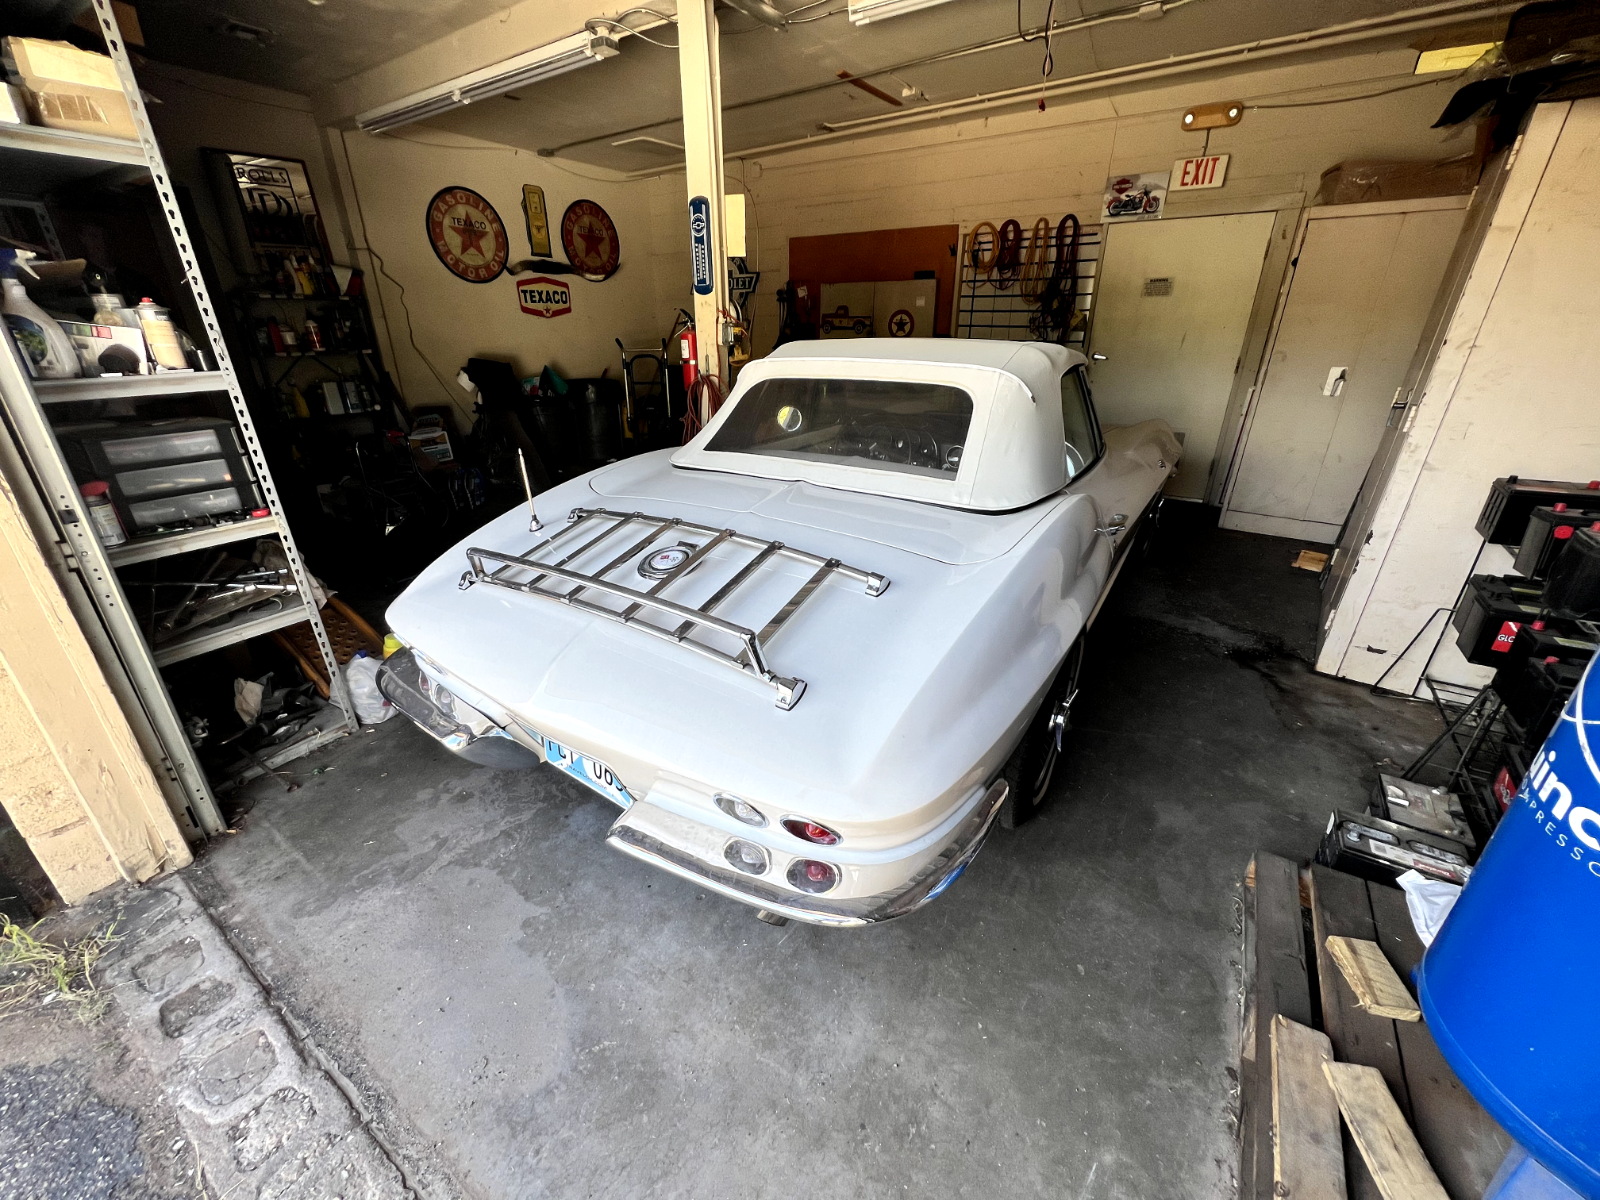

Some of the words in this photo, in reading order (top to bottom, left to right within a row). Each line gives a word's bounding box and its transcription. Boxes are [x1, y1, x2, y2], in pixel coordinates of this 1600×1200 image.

[236, 167, 287, 184] ROLLS
[1180, 156, 1220, 186] EXIT
[433, 192, 501, 232] GASOLINE
[451, 217, 487, 230] TEXACO
[521, 289, 568, 304] TEXACO
